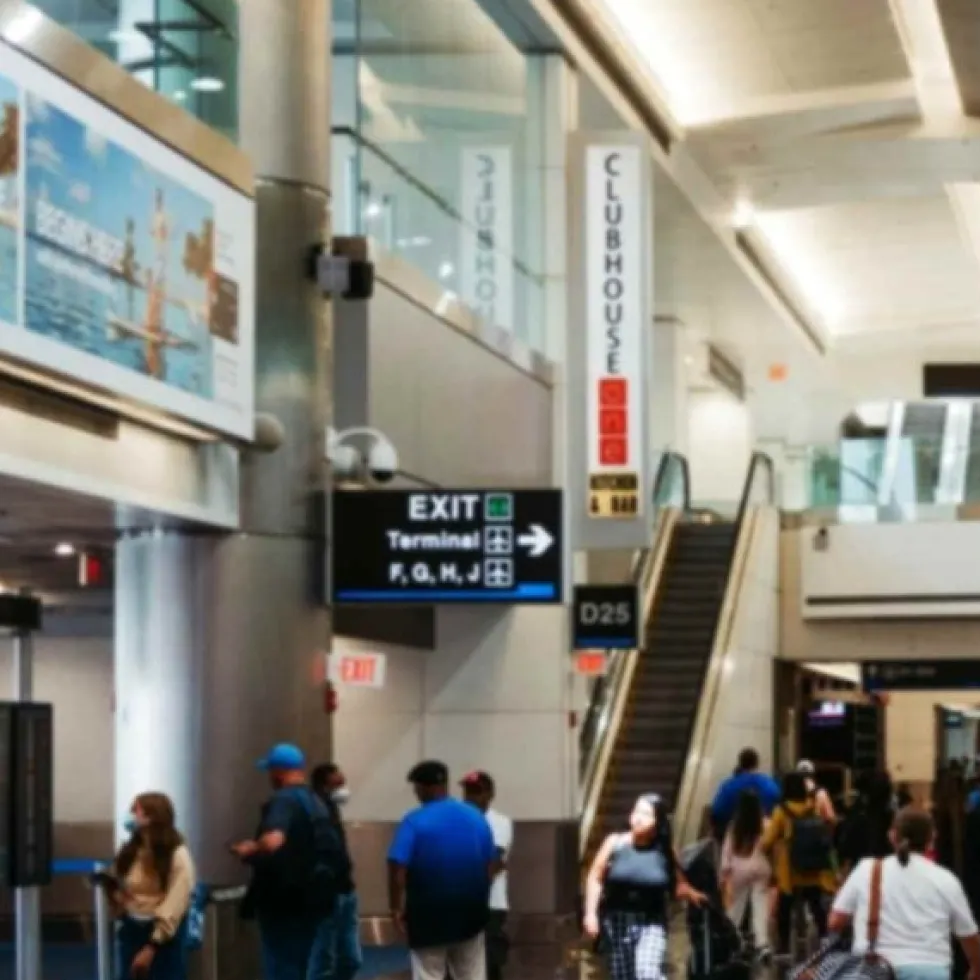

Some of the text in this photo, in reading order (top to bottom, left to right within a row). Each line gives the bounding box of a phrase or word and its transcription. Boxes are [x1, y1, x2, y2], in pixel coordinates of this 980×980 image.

[603, 152, 624, 374] CLUBHOUSE
[408, 495, 479, 520] EXIT
[386, 530, 480, 550] Terminal
[389, 563, 480, 584] F, G, H, J
[580, 603, 631, 625] D25
[340, 655, 376, 682] EXIT
